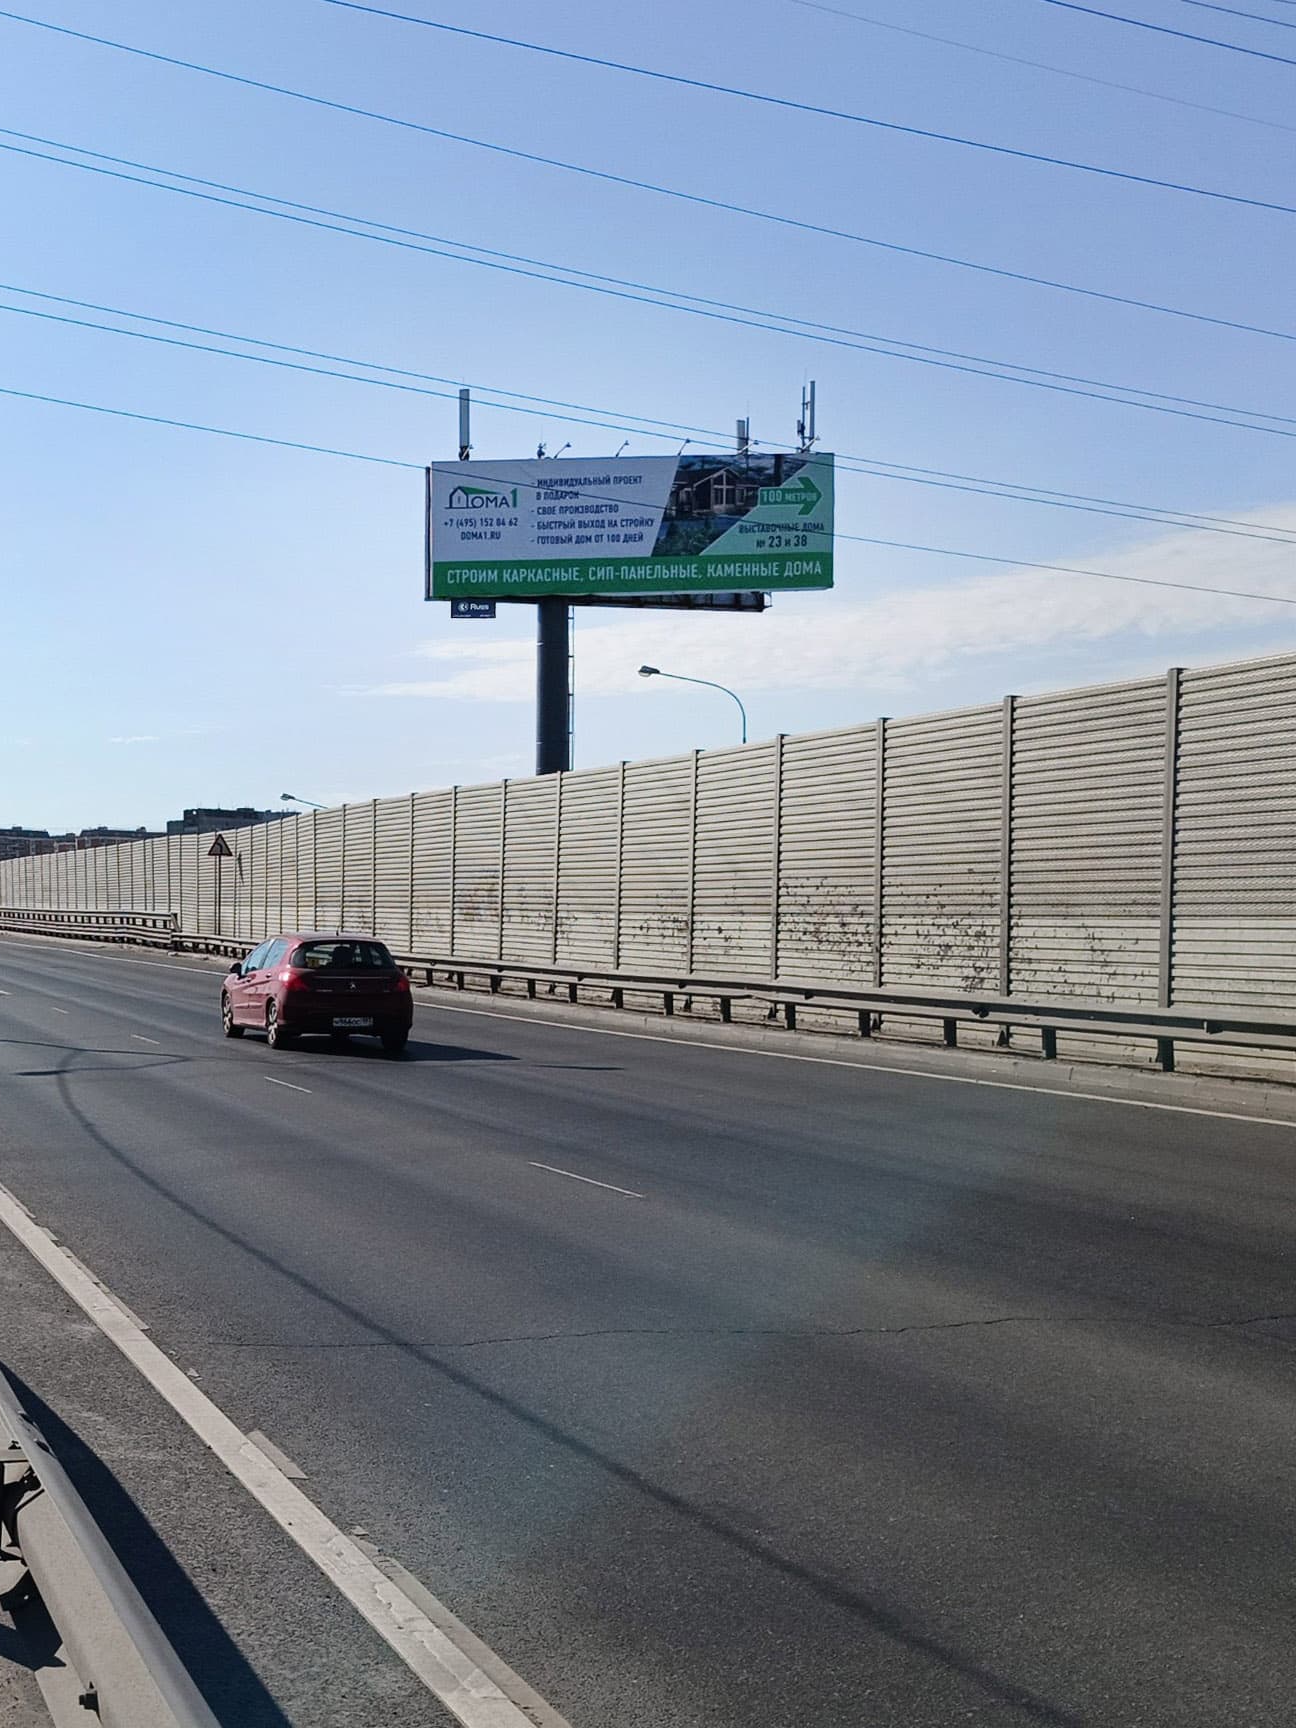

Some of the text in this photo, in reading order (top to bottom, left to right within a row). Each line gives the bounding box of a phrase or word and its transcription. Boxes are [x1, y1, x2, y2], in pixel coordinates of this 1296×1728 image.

[537, 475, 642, 488] ИНДИВИДУАЛЬНЫЙ ПРОЕКТ
[536, 490, 579, 501] В ПОДАРОК
[762, 490, 782, 502] 100
[537, 504, 619, 515] СВОЕ ПРОИЗВОДСТВО
[444, 518, 453, 527] +7
[456, 518, 477, 529] (495)
[480, 517, 494, 527] 152
[508, 517, 519, 527] 62
[537, 516, 654, 530] БЫСТРЫЙ ВЫХОД НА СТРОЙКУ
[739, 522, 825, 534] ВЫСТАВОЧНЫЕ ДОМА
[461, 531, 501, 541] DOMA1.RU
[537, 531, 644, 545] ГОТОВЫЙ ДОМ ОТ 100 ДНЕЙ
[768, 535, 782, 548] 23
[794, 534, 808, 546] 38
[447, 560, 822, 585] СТРОИМ КАРКАСНЫЕ, СИП-ПАНЕЛЬНЫЕ, КАМЕННЫЕ ДОМА
